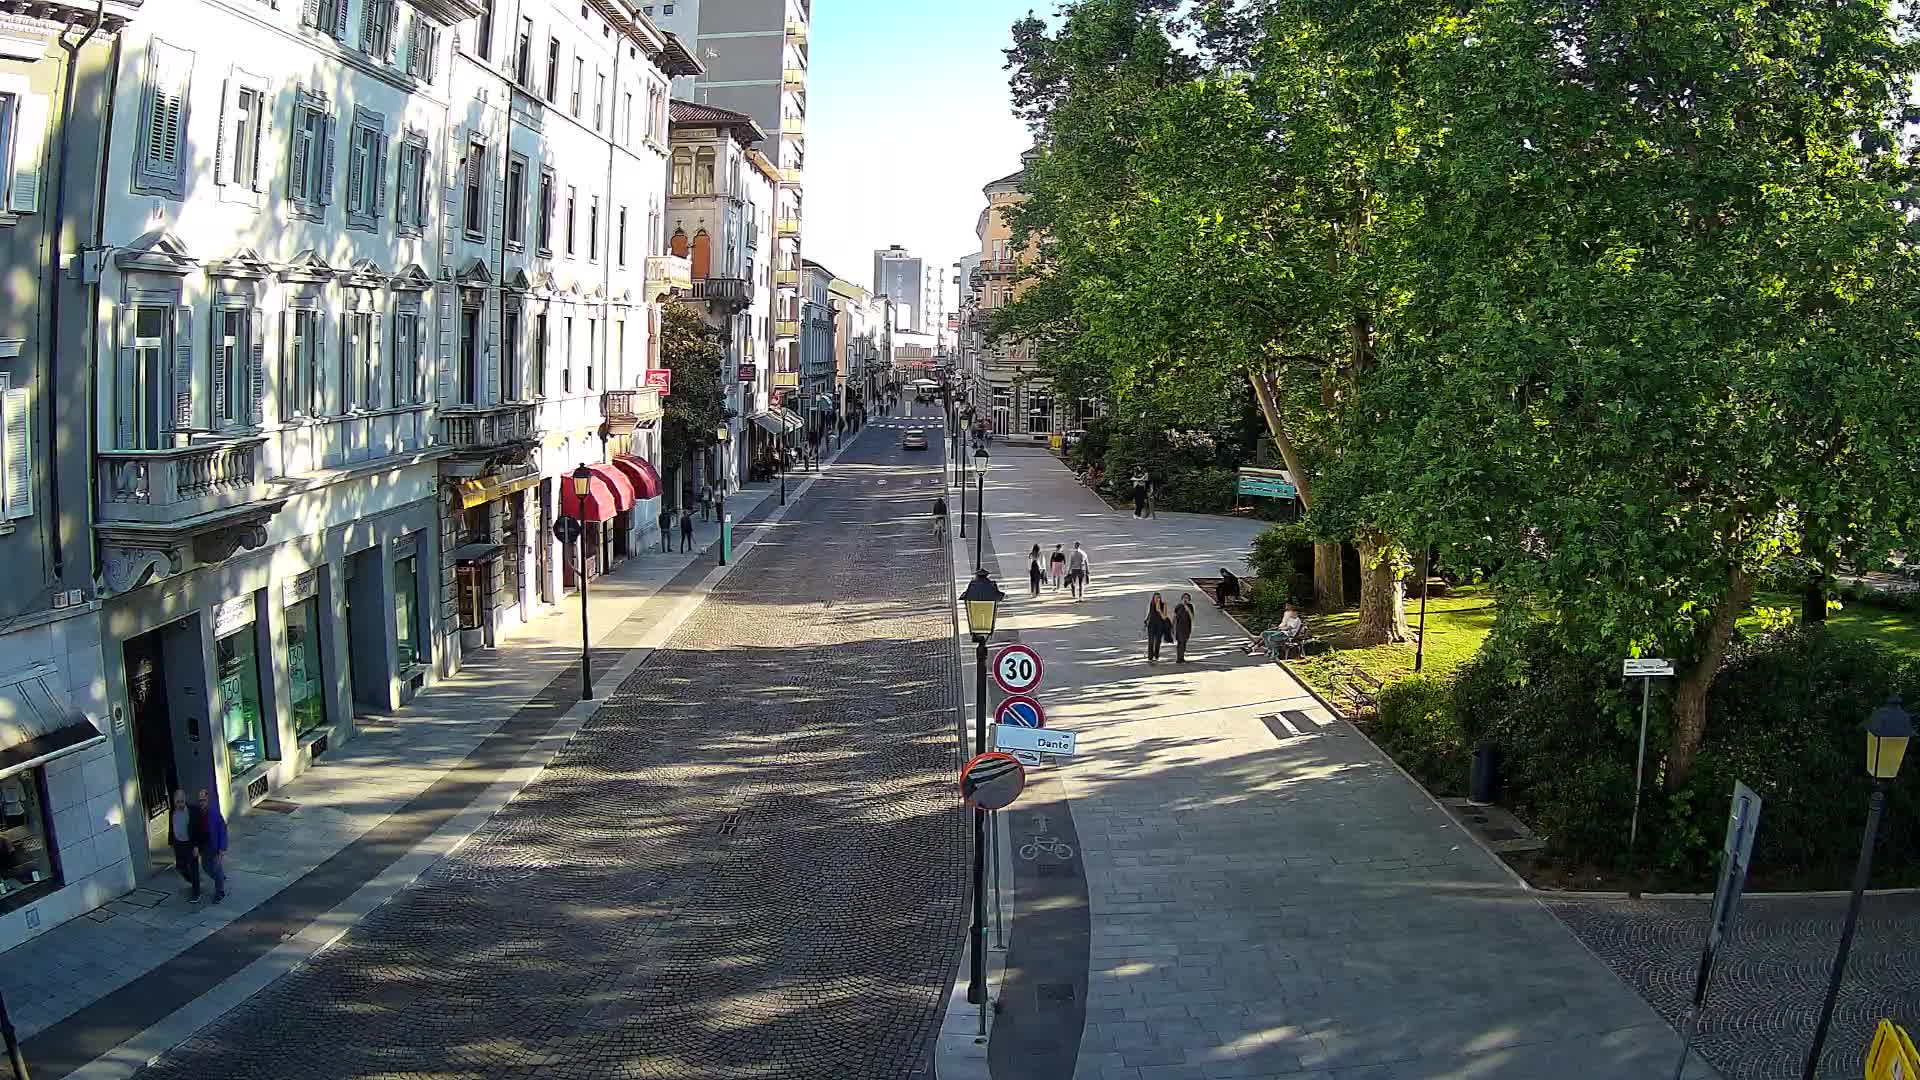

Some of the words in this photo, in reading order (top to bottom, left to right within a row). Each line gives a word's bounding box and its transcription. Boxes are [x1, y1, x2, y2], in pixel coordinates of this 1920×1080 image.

[1004, 658, 1033, 680] 30
[221, 677, 240, 700] 130
[1037, 738, 1069, 750] Dante
